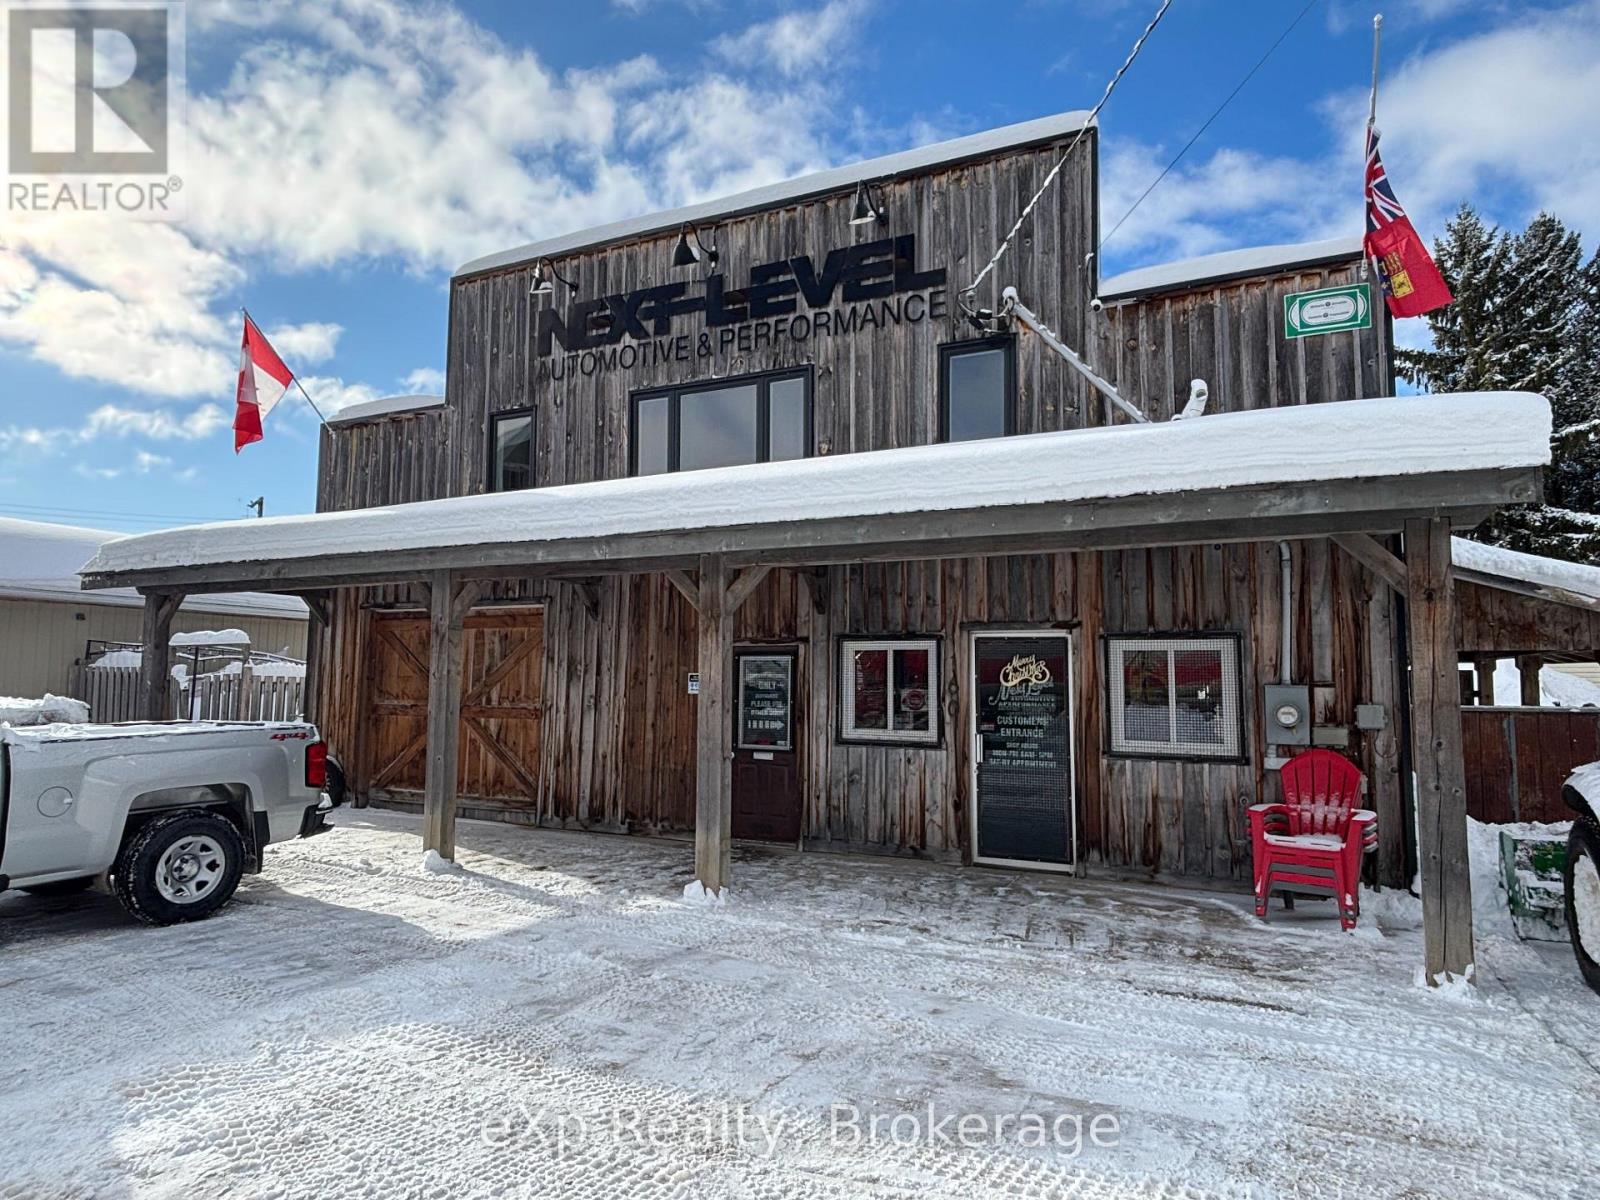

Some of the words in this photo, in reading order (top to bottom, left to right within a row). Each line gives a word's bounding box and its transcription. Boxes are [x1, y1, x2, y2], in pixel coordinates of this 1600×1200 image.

[537, 333, 690, 382] AUTOMOTIVE
[697, 332, 713, 357] &
[719, 290, 948, 355] PERFORMANCE
[1000, 728, 1044, 738] ENTRANCE
